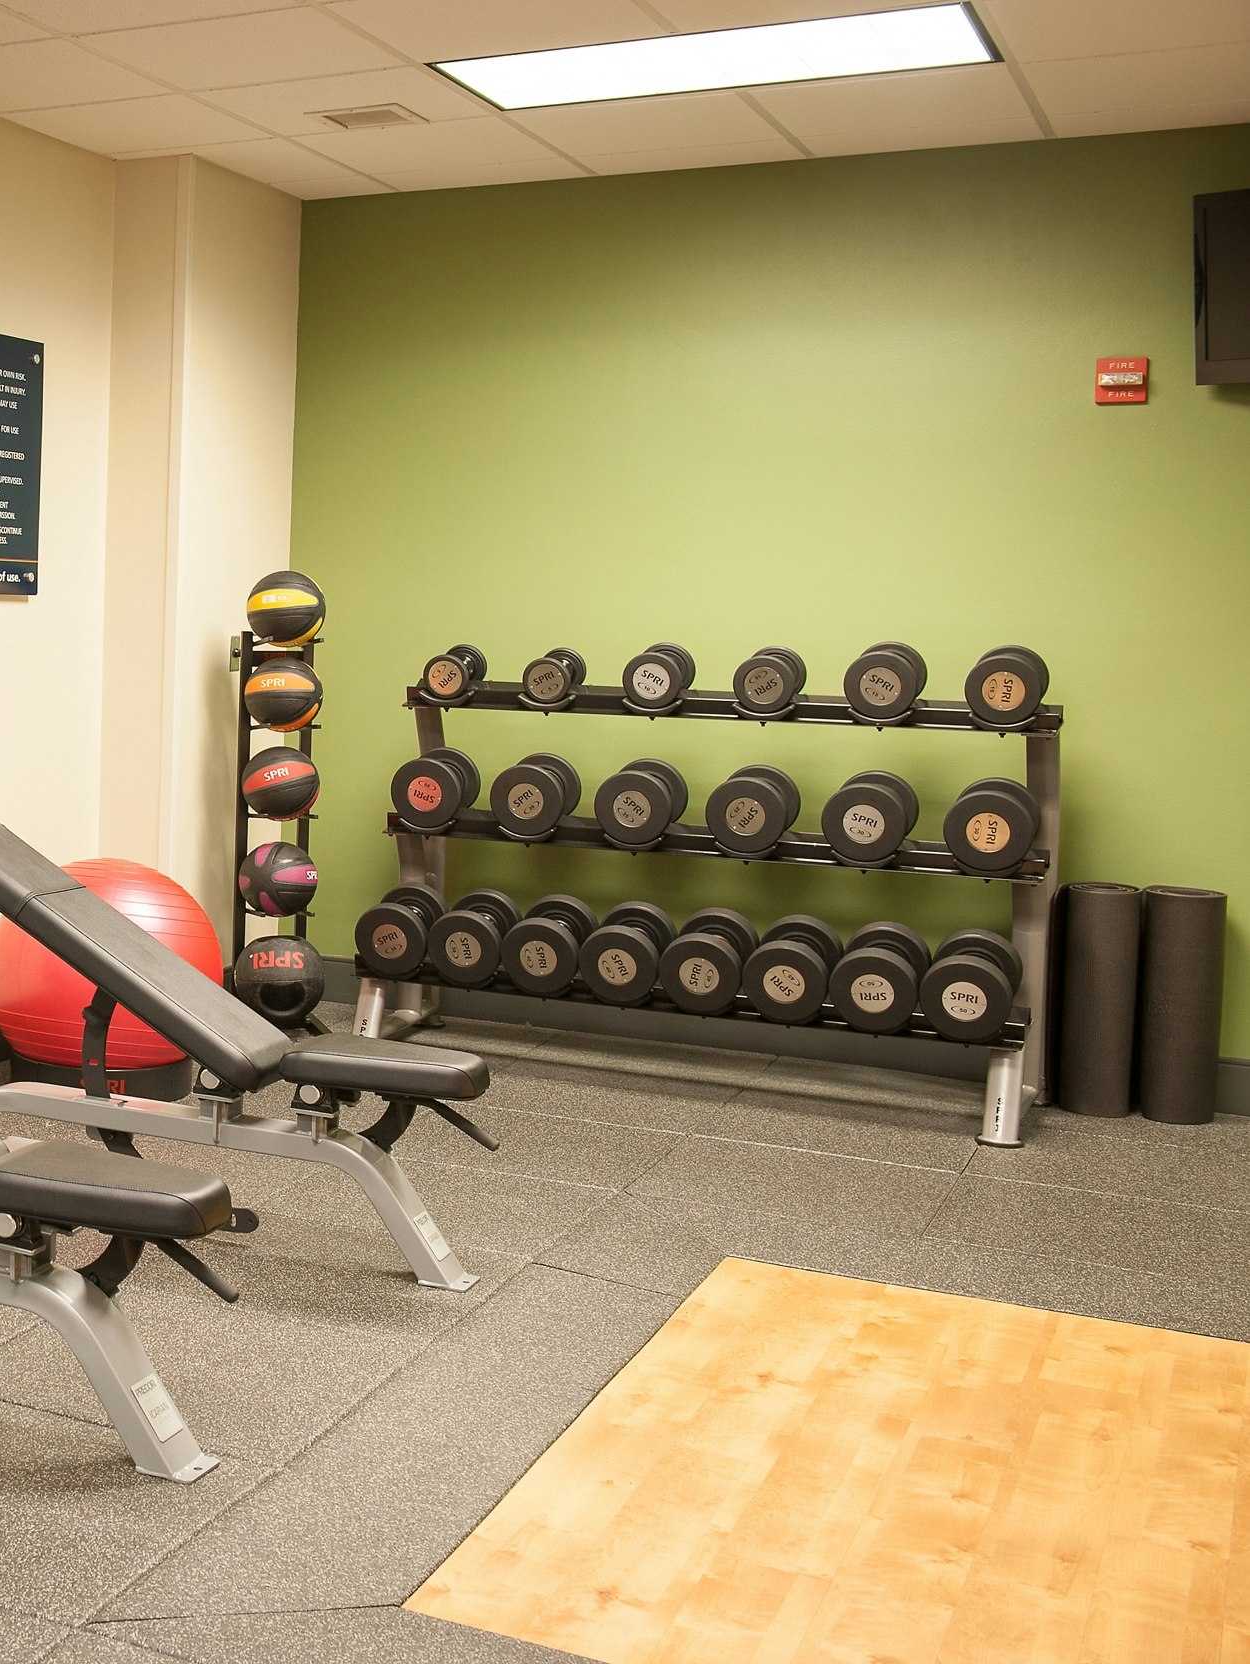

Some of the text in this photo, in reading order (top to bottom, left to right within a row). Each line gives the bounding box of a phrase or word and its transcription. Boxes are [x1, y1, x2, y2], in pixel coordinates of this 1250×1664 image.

[2, 370, 15, 378] OWN
[15, 372, 27, 381] RISK.
[4, 385, 10, 393] IN
[10, 386, 27, 396] INJURY.
[9, 401, 18, 410] USE
[1, 424, 10, 434] FOR
[10, 426, 20, 435] USE
[0, 450, 25, 461] REGISTERED
[6, 573, 21, 583] use.
[260, 678, 285, 688] SPRI
[438, 670, 457, 690] SPRI
[533, 671, 555, 687] SPRI
[641, 669, 665, 687] SPRI
[868, 674, 895, 693] SPRI
[755, 678, 778, 697] SPRI
[1001, 678, 1013, 704] SPRI
[264, 766, 290, 781] SPRI
[413, 789, 435, 804] SPRI
[513, 791, 534, 808] SPRI
[622, 796, 645, 817] SPRI
[740, 806, 758, 829] SPRI
[851, 812, 878, 828] SPRI
[986, 820, 998, 845] SPRI
[377, 931, 399, 946] SPRI
[459, 937, 472, 960] SPRI
[253, 950, 304, 970] SPRI
[535, 946, 548, 969] SPRI
[610, 954, 629, 977] SPRI
[689, 963, 703, 987] SPRI
[770, 975, 794, 997] SPRI
[859, 992, 887, 1001] SPRI
[950, 991, 979, 1004] SPRI
